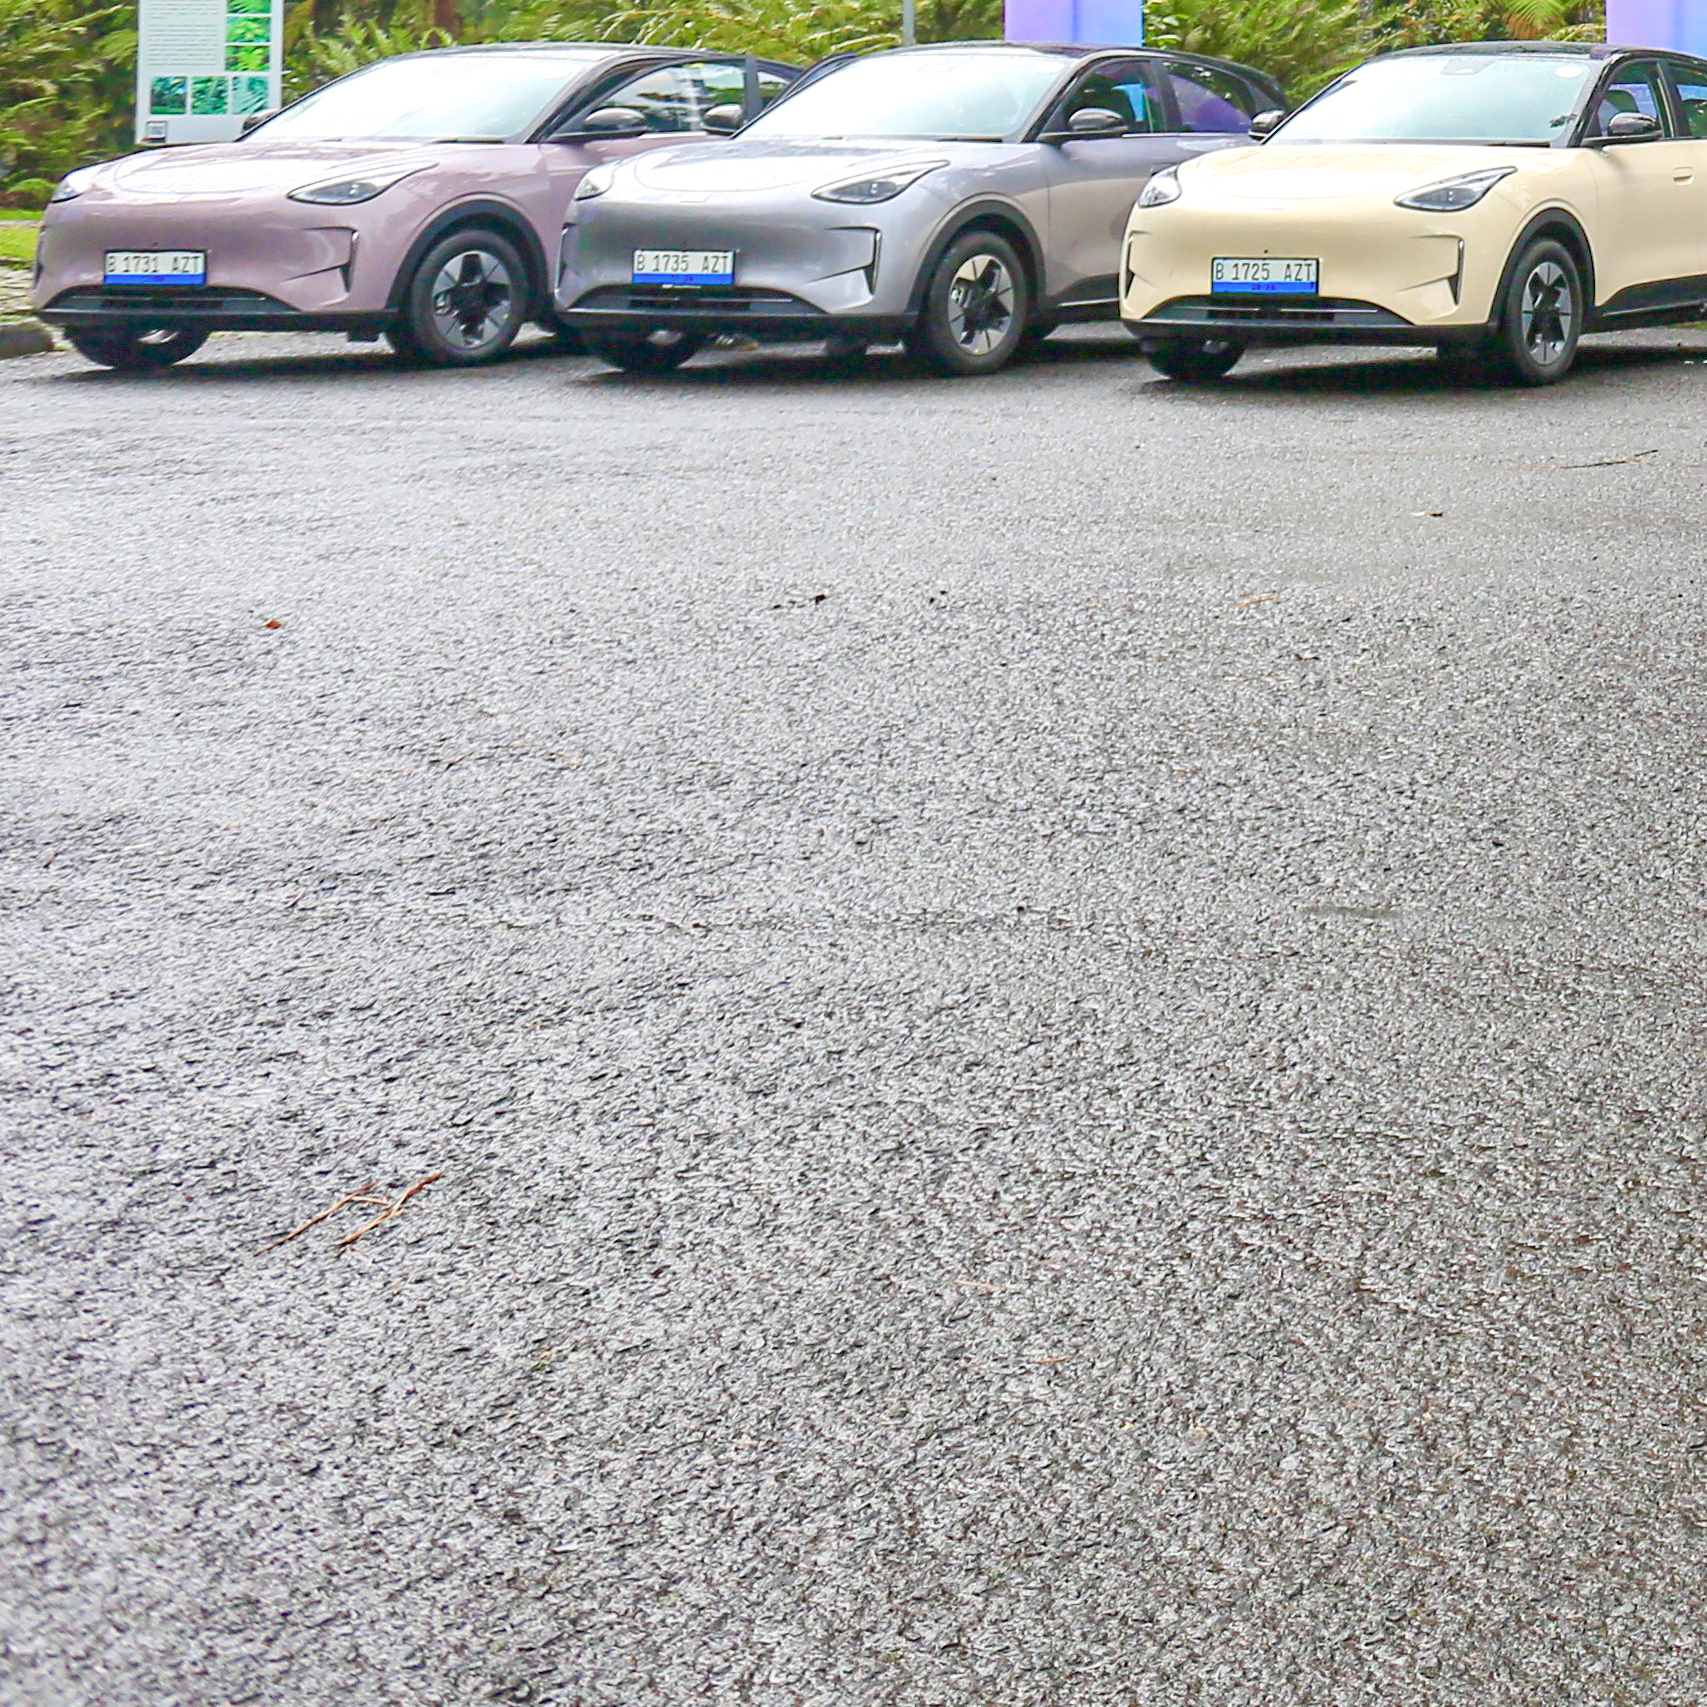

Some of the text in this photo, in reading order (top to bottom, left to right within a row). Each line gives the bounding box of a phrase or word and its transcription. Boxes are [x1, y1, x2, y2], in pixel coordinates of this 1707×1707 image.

[109, 256, 200, 273] B 1731 AZT
[636, 254, 728, 273] B 1735 AZT
[1215, 262, 1313, 281] B 1725 AZT
